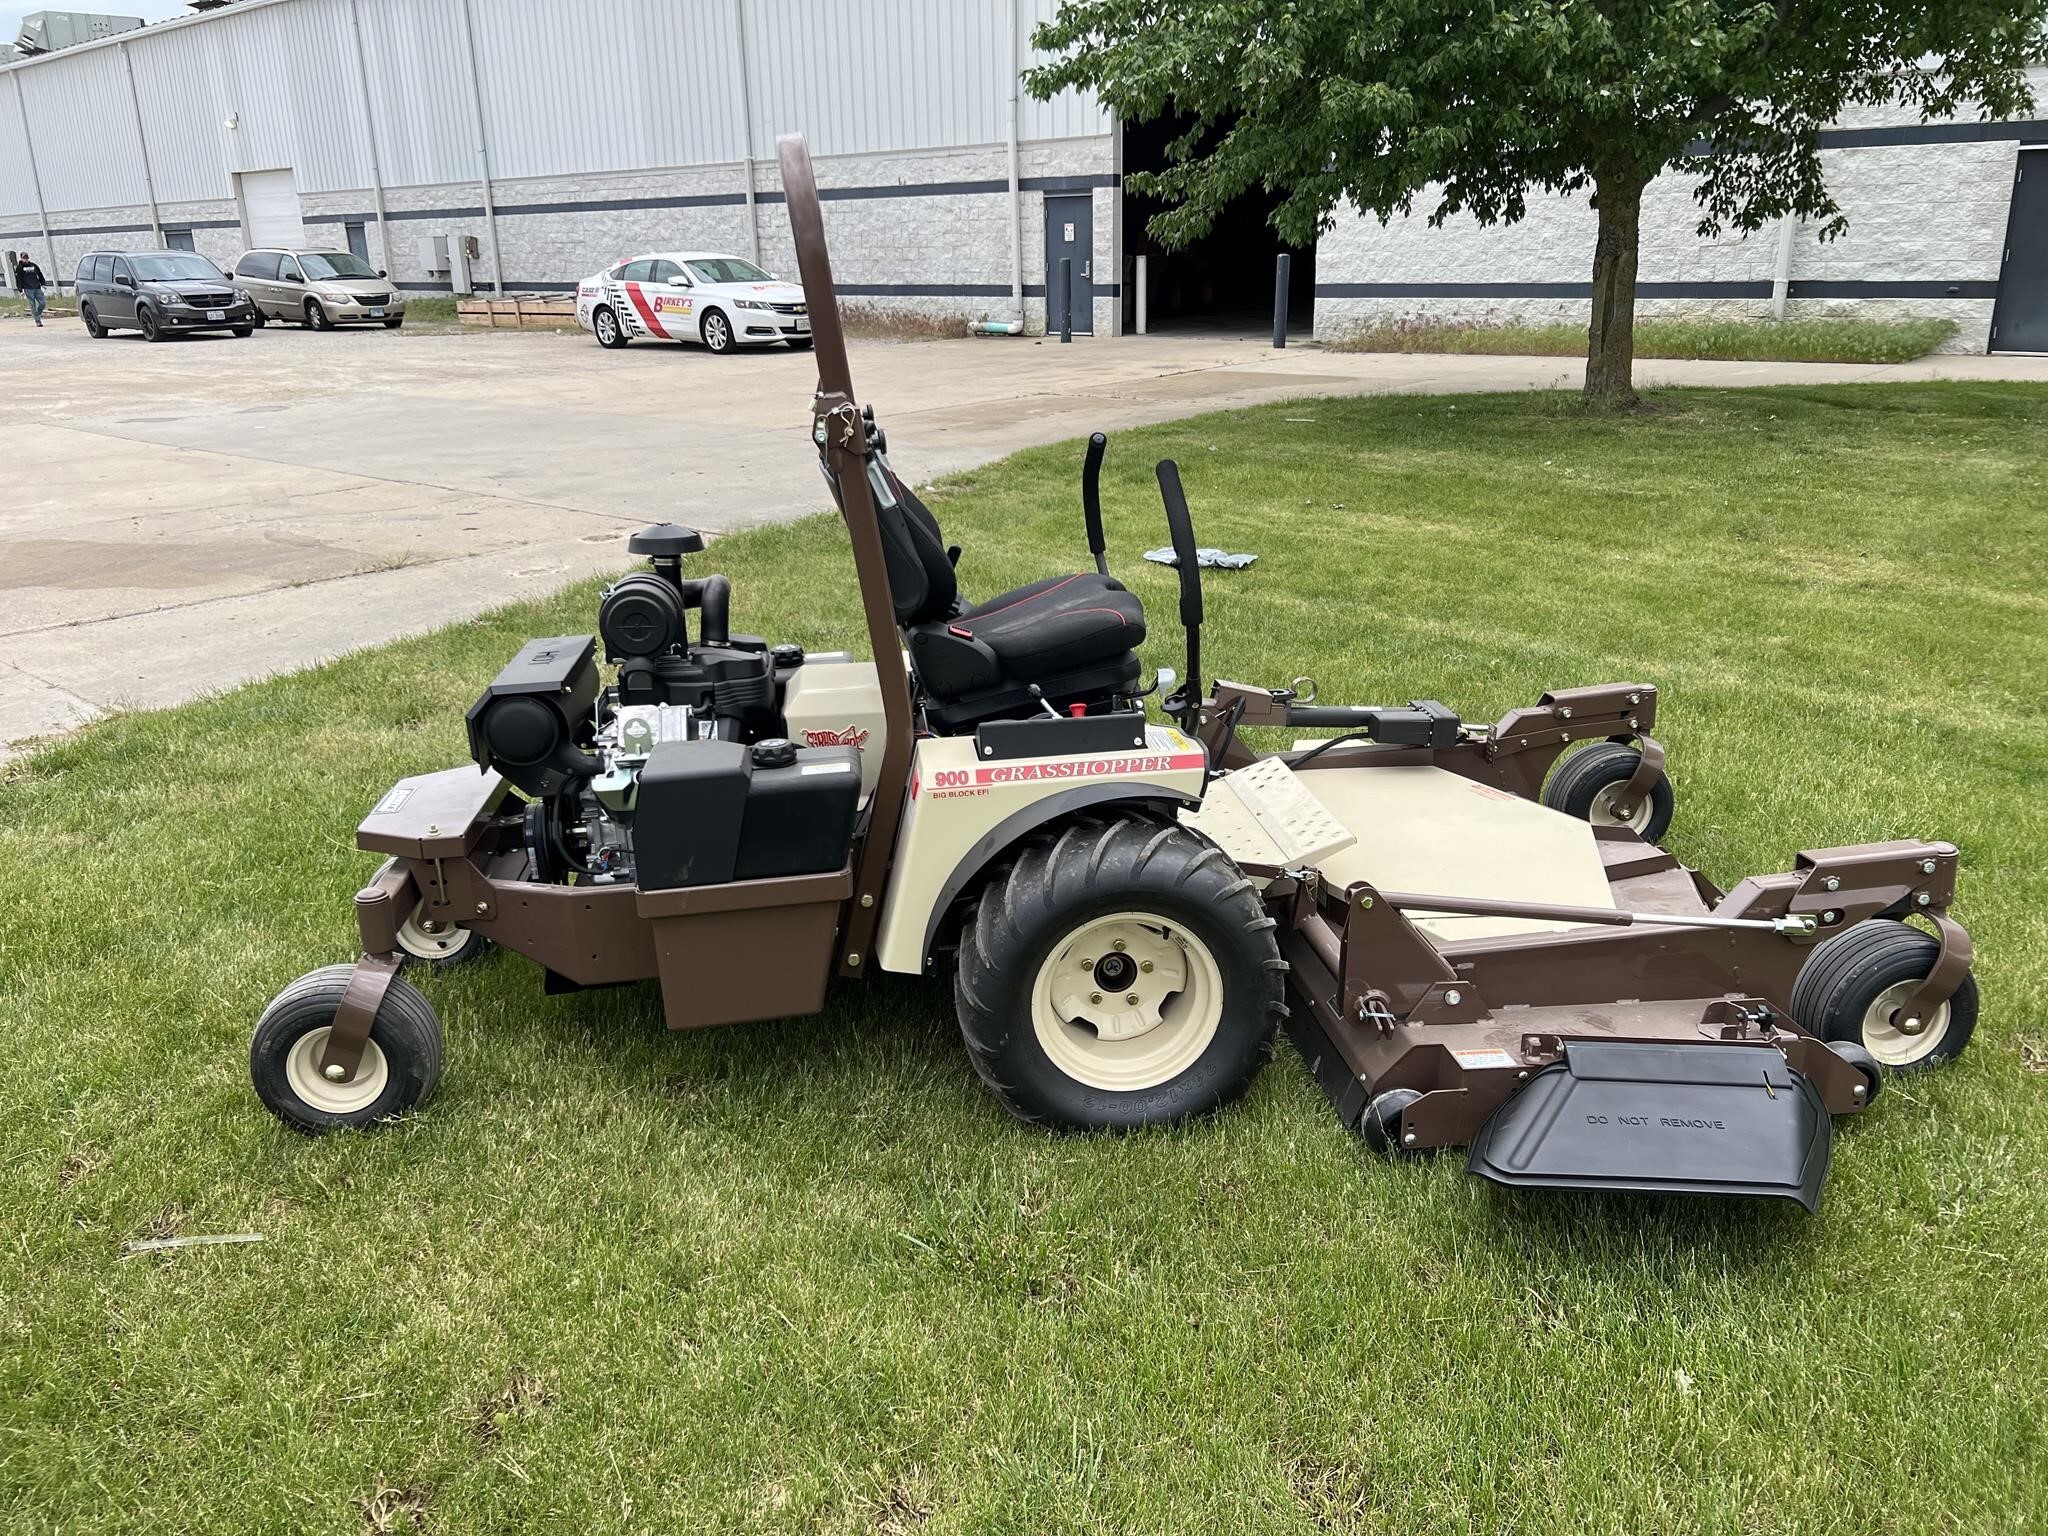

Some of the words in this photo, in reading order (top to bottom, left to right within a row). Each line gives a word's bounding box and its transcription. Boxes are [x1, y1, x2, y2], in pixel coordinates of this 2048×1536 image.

[654, 296, 693, 313] BIRKEY'S
[935, 770, 969, 787] 900
[990, 756, 1172, 783] GRASSHOPPER
[933, 791, 947, 799] BIG
[948, 789, 975, 798] BLOCK
[977, 788, 990, 796] EFI
[1586, 1115, 1609, 1125] DO
[1617, 1116, 1649, 1126] NOT
[1659, 1117, 1726, 1130] REMOVE
